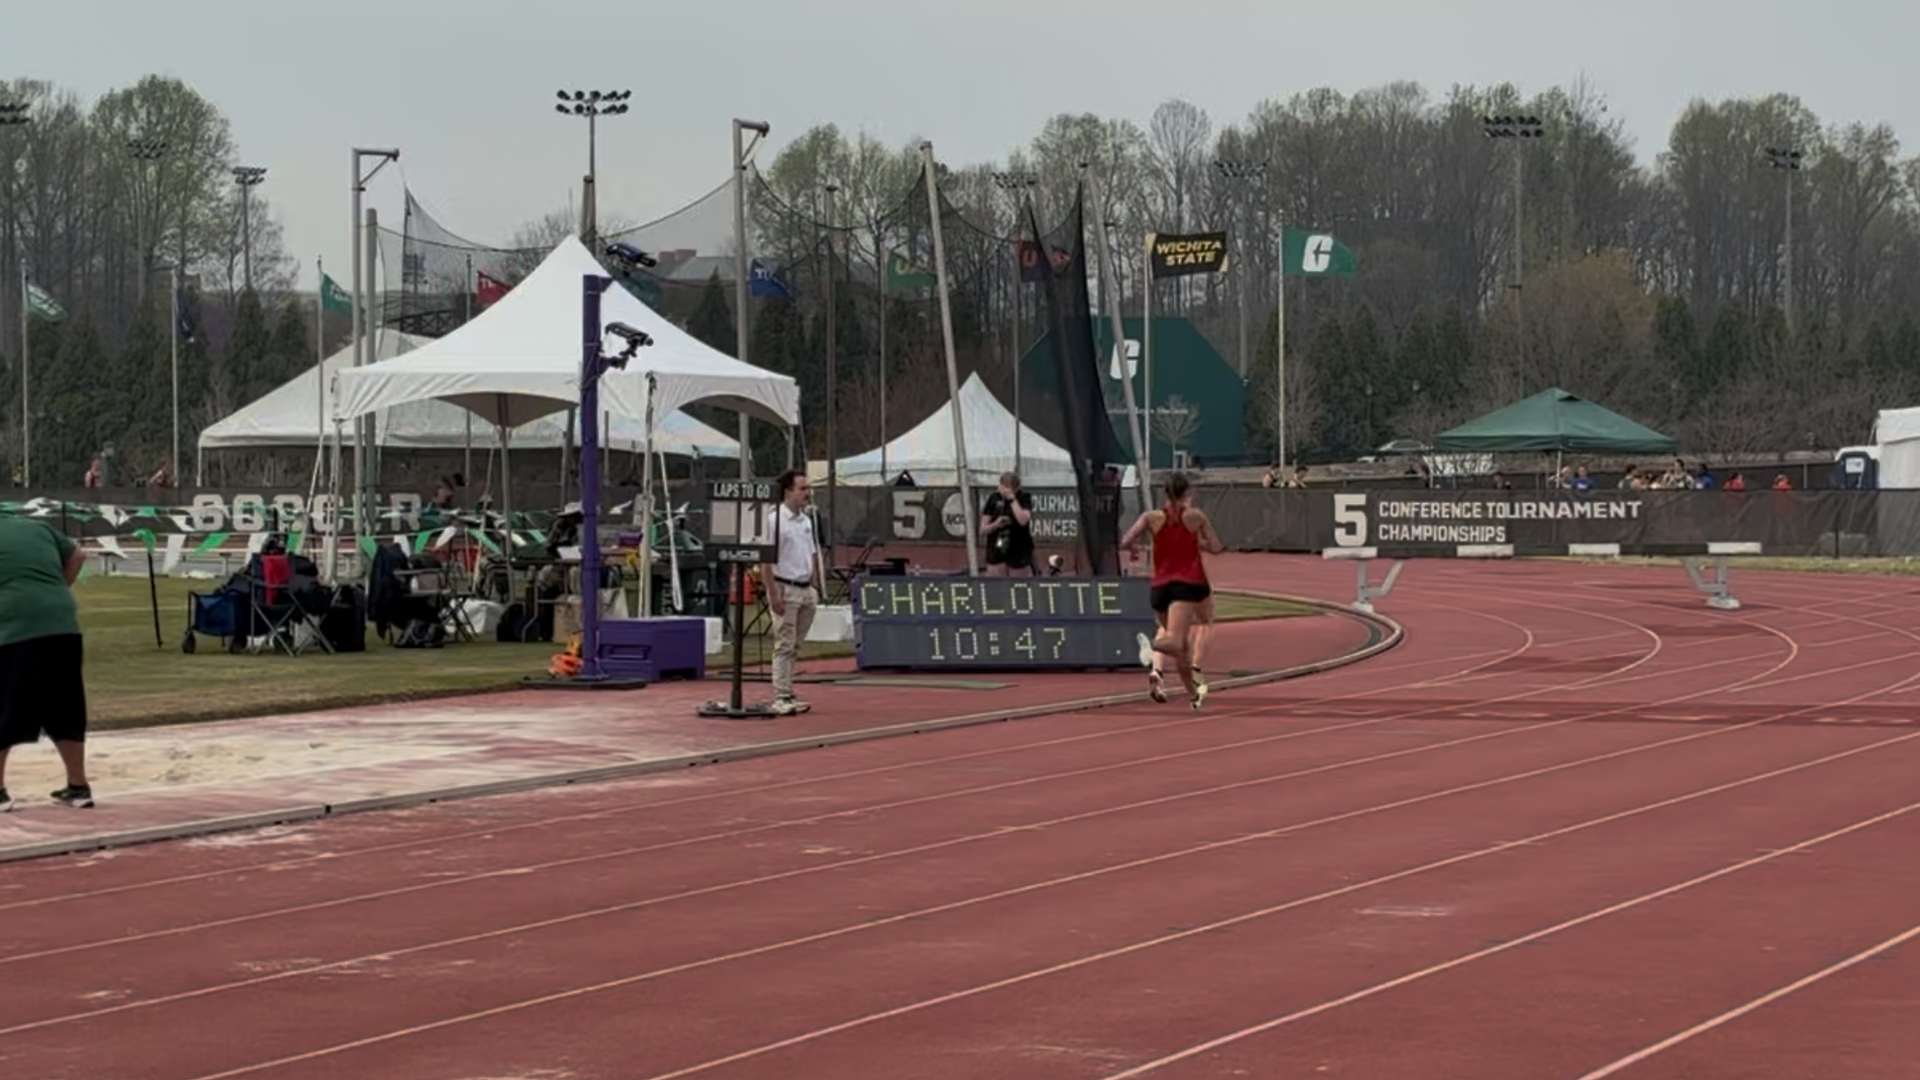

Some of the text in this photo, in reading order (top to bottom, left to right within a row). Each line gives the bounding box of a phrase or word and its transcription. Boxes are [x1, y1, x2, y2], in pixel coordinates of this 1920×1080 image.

[1156, 240, 1222, 255] WICHITA
[1165, 250, 1215, 266] STATE
[713, 482, 771, 499] LAPS TO GO
[747, 501, 763, 537] 1
[892, 490, 926, 539] 5
[1334, 494, 1367, 547] 5
[1378, 500, 1643, 519] CONFERENCE TOURNAMENT
[1378, 523, 1506, 542] CHAMPIONSHIPS
[860, 582, 1122, 614] CHARLOTTE
[929, 627, 1066, 660] 10:47
